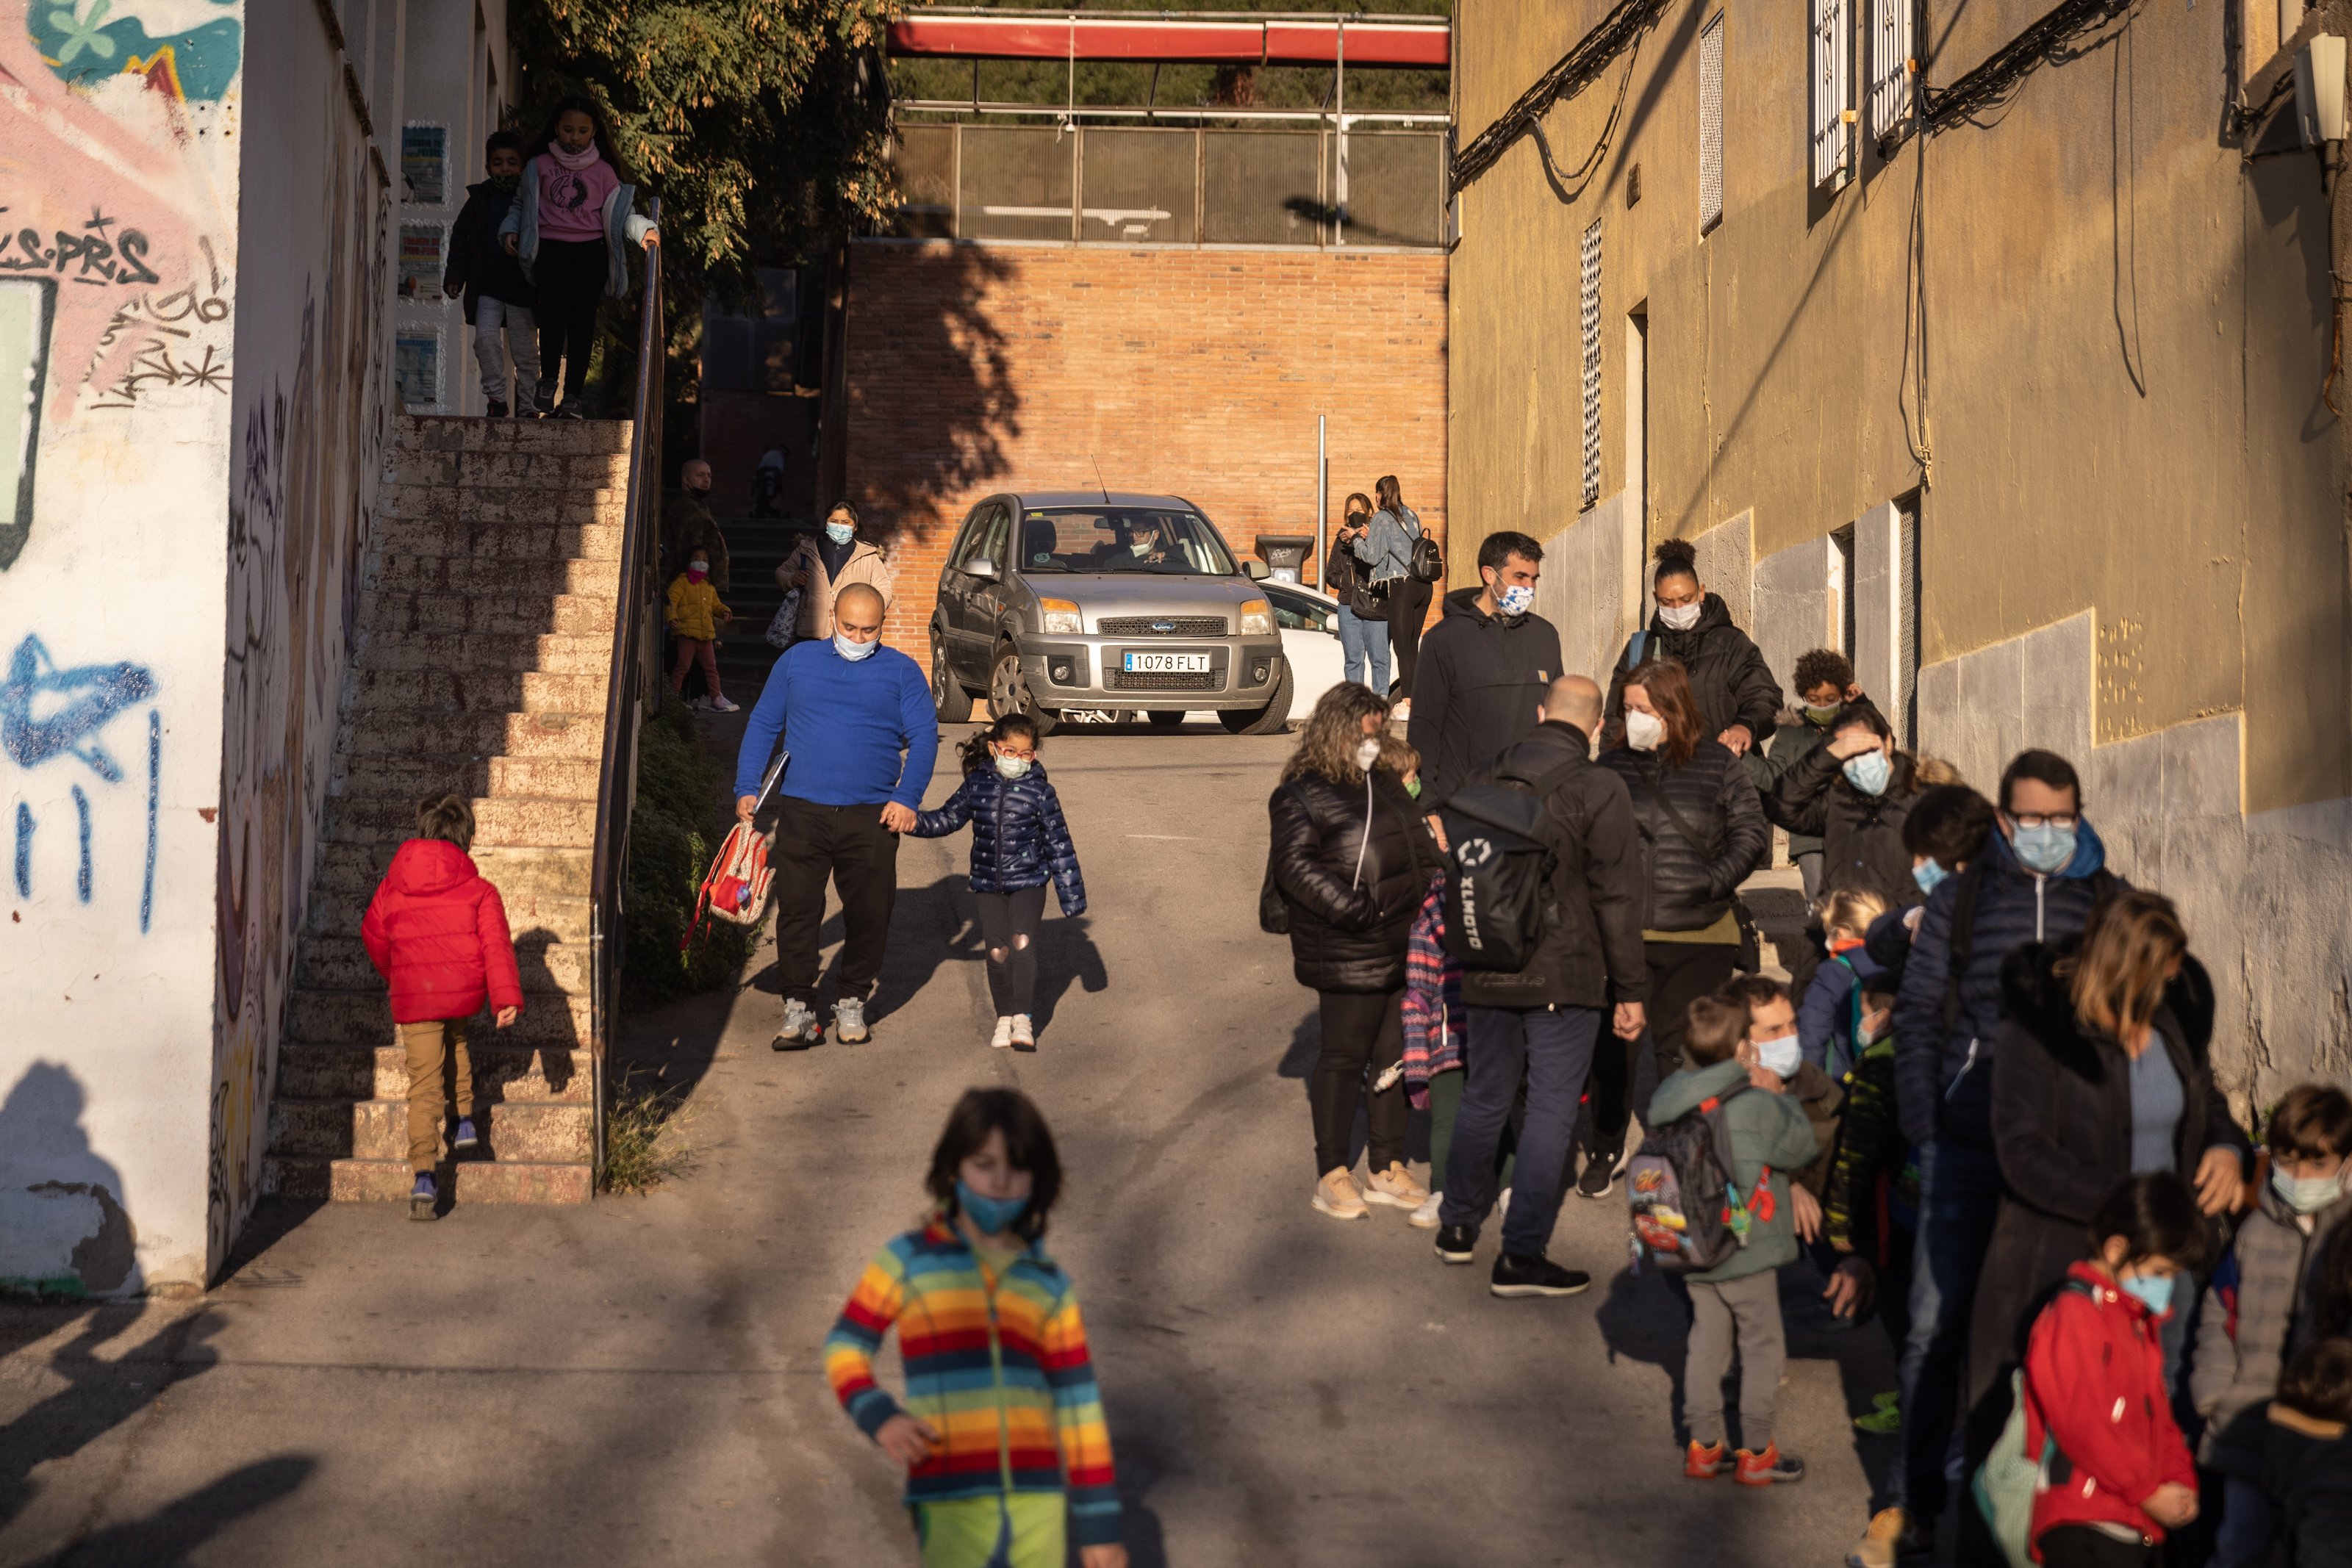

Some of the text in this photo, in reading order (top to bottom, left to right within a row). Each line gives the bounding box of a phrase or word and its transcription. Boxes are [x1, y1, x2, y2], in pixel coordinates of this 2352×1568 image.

[1138, 655, 1173, 669] 1078
[1177, 656, 1205, 670] FLT
[1460, 875, 1483, 951] XLMOTO
